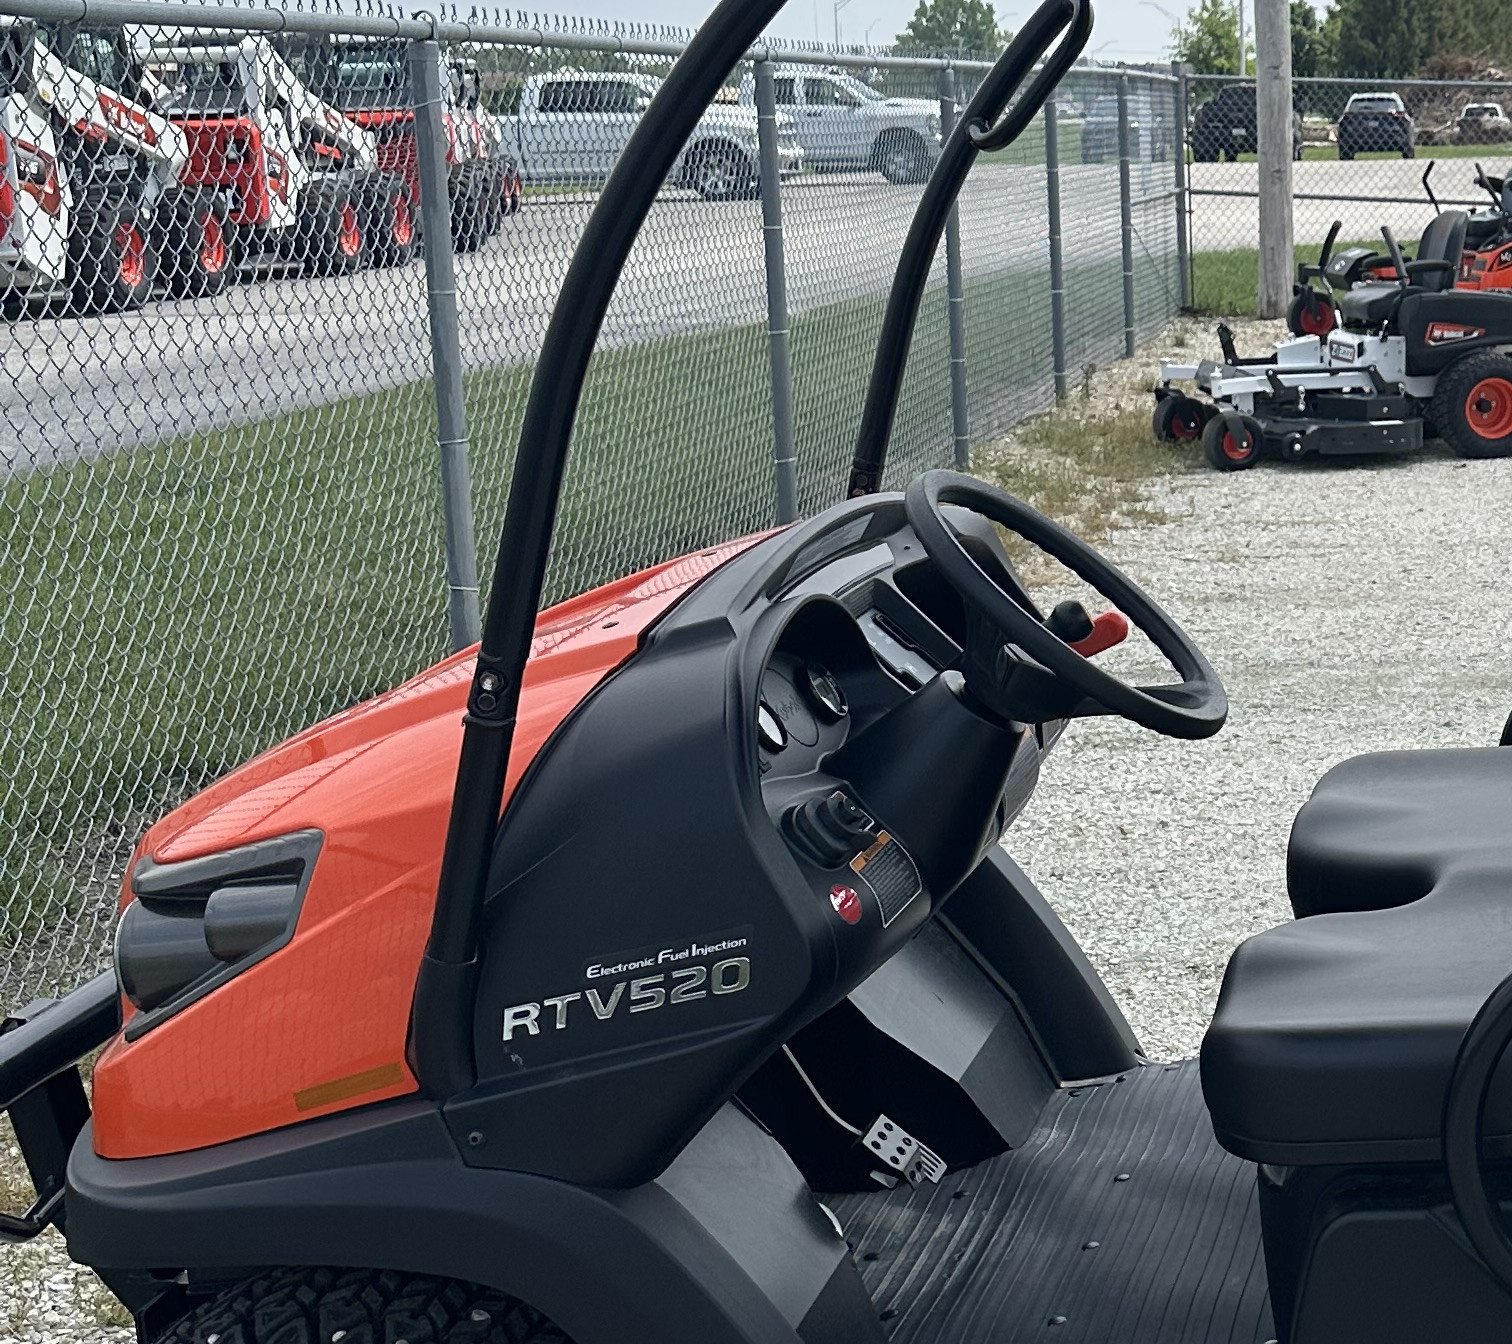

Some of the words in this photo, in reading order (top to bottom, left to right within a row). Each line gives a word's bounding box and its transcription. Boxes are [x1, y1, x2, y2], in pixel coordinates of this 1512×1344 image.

[586, 957, 655, 979] Electronic
[657, 949, 689, 964] Fuel
[691, 938, 747, 957] Injection
[502, 956, 751, 1041] RTV520
